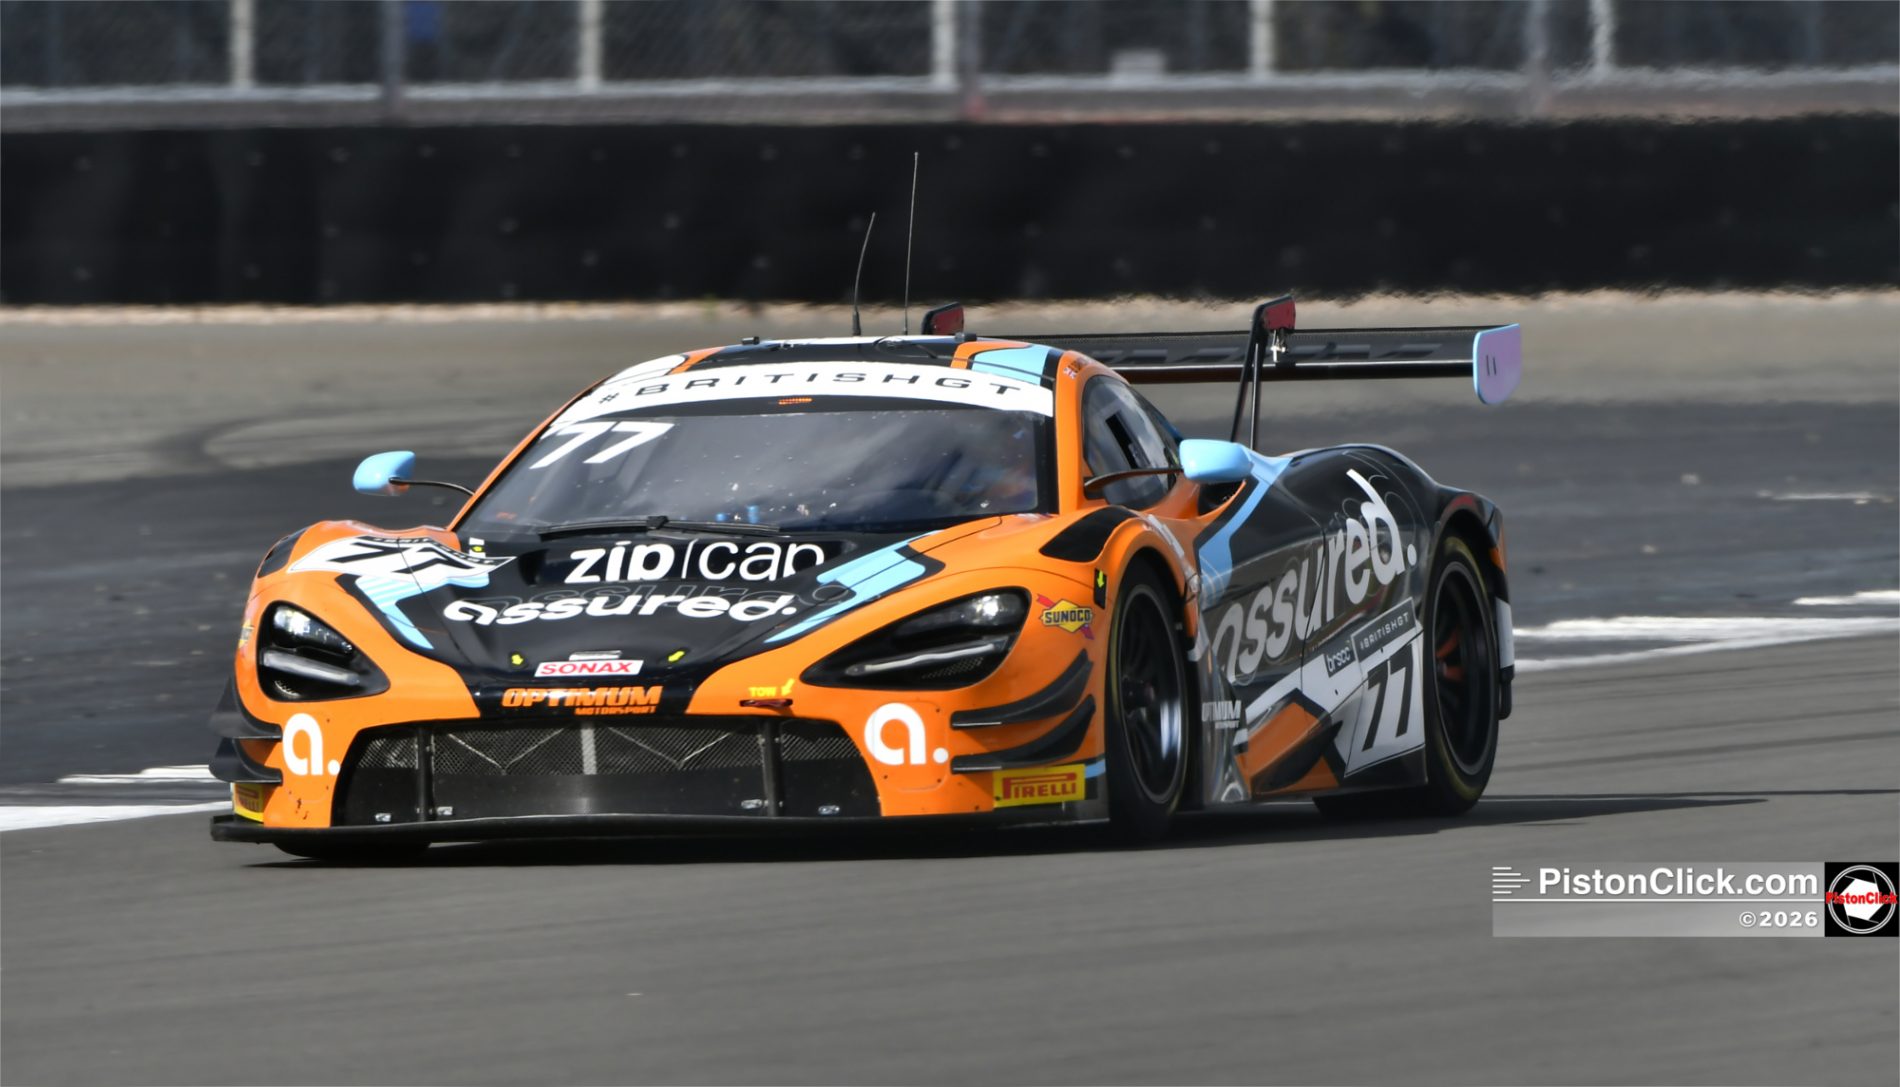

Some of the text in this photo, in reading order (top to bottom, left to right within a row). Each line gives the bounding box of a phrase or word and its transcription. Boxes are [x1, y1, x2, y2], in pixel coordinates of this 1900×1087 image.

[529, 421, 675, 469] 77
[443, 594, 798, 626] assured.
[1044, 607, 1092, 624] SUNOCO
[541, 661, 634, 675] SONAX
[502, 685, 664, 708] OPTIMUM
[748, 686, 777, 697] TOW
[1361, 642, 1414, 752] 77
[1002, 771, 1078, 800] PIRELLI
